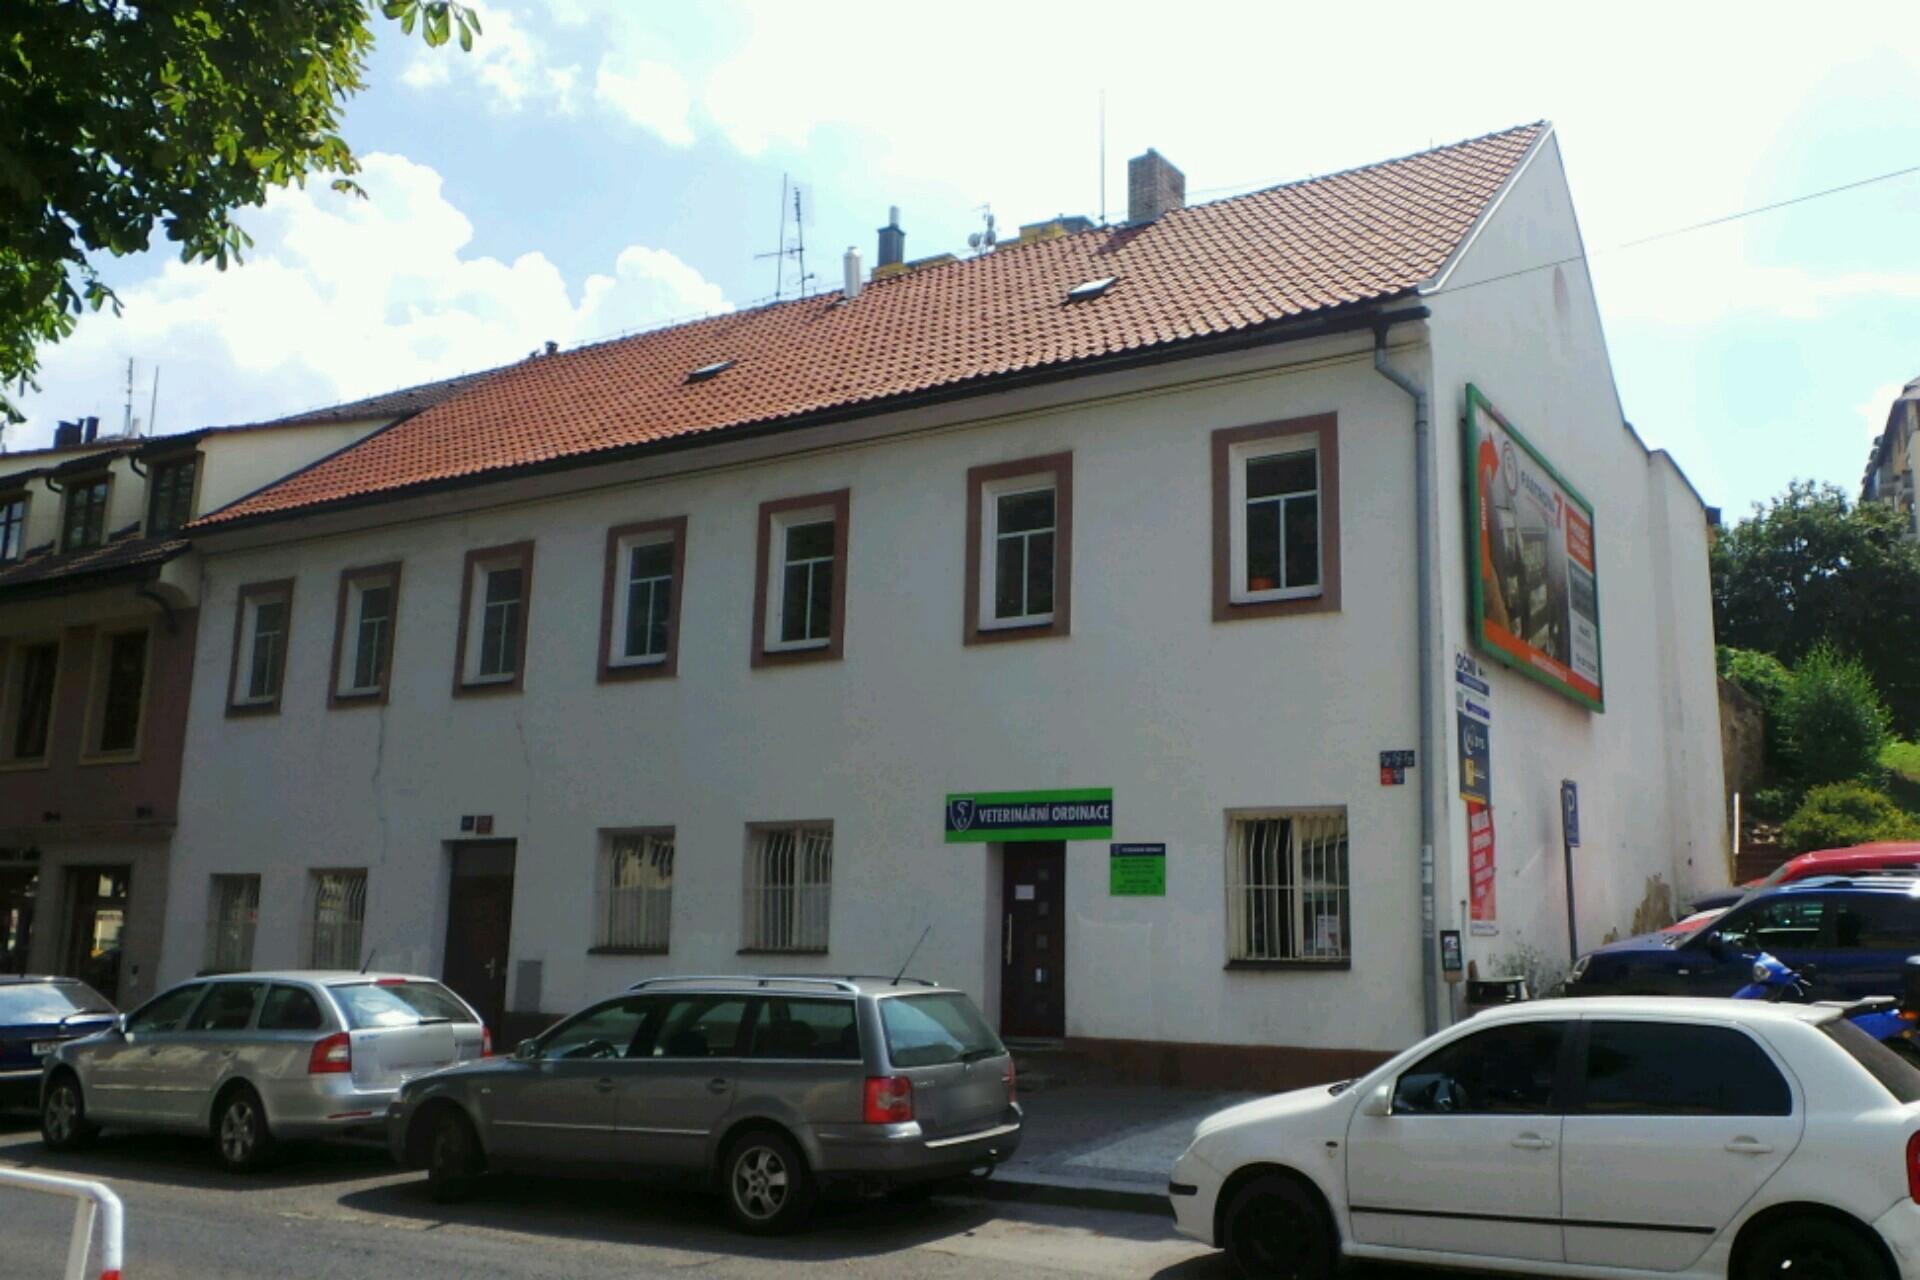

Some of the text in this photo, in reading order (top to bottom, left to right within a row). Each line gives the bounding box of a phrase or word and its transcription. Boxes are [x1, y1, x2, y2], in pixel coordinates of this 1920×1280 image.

[979, 803, 1109, 823] VETERINÁRNÍ ORDINACE
[1566, 789, 1575, 823] P
